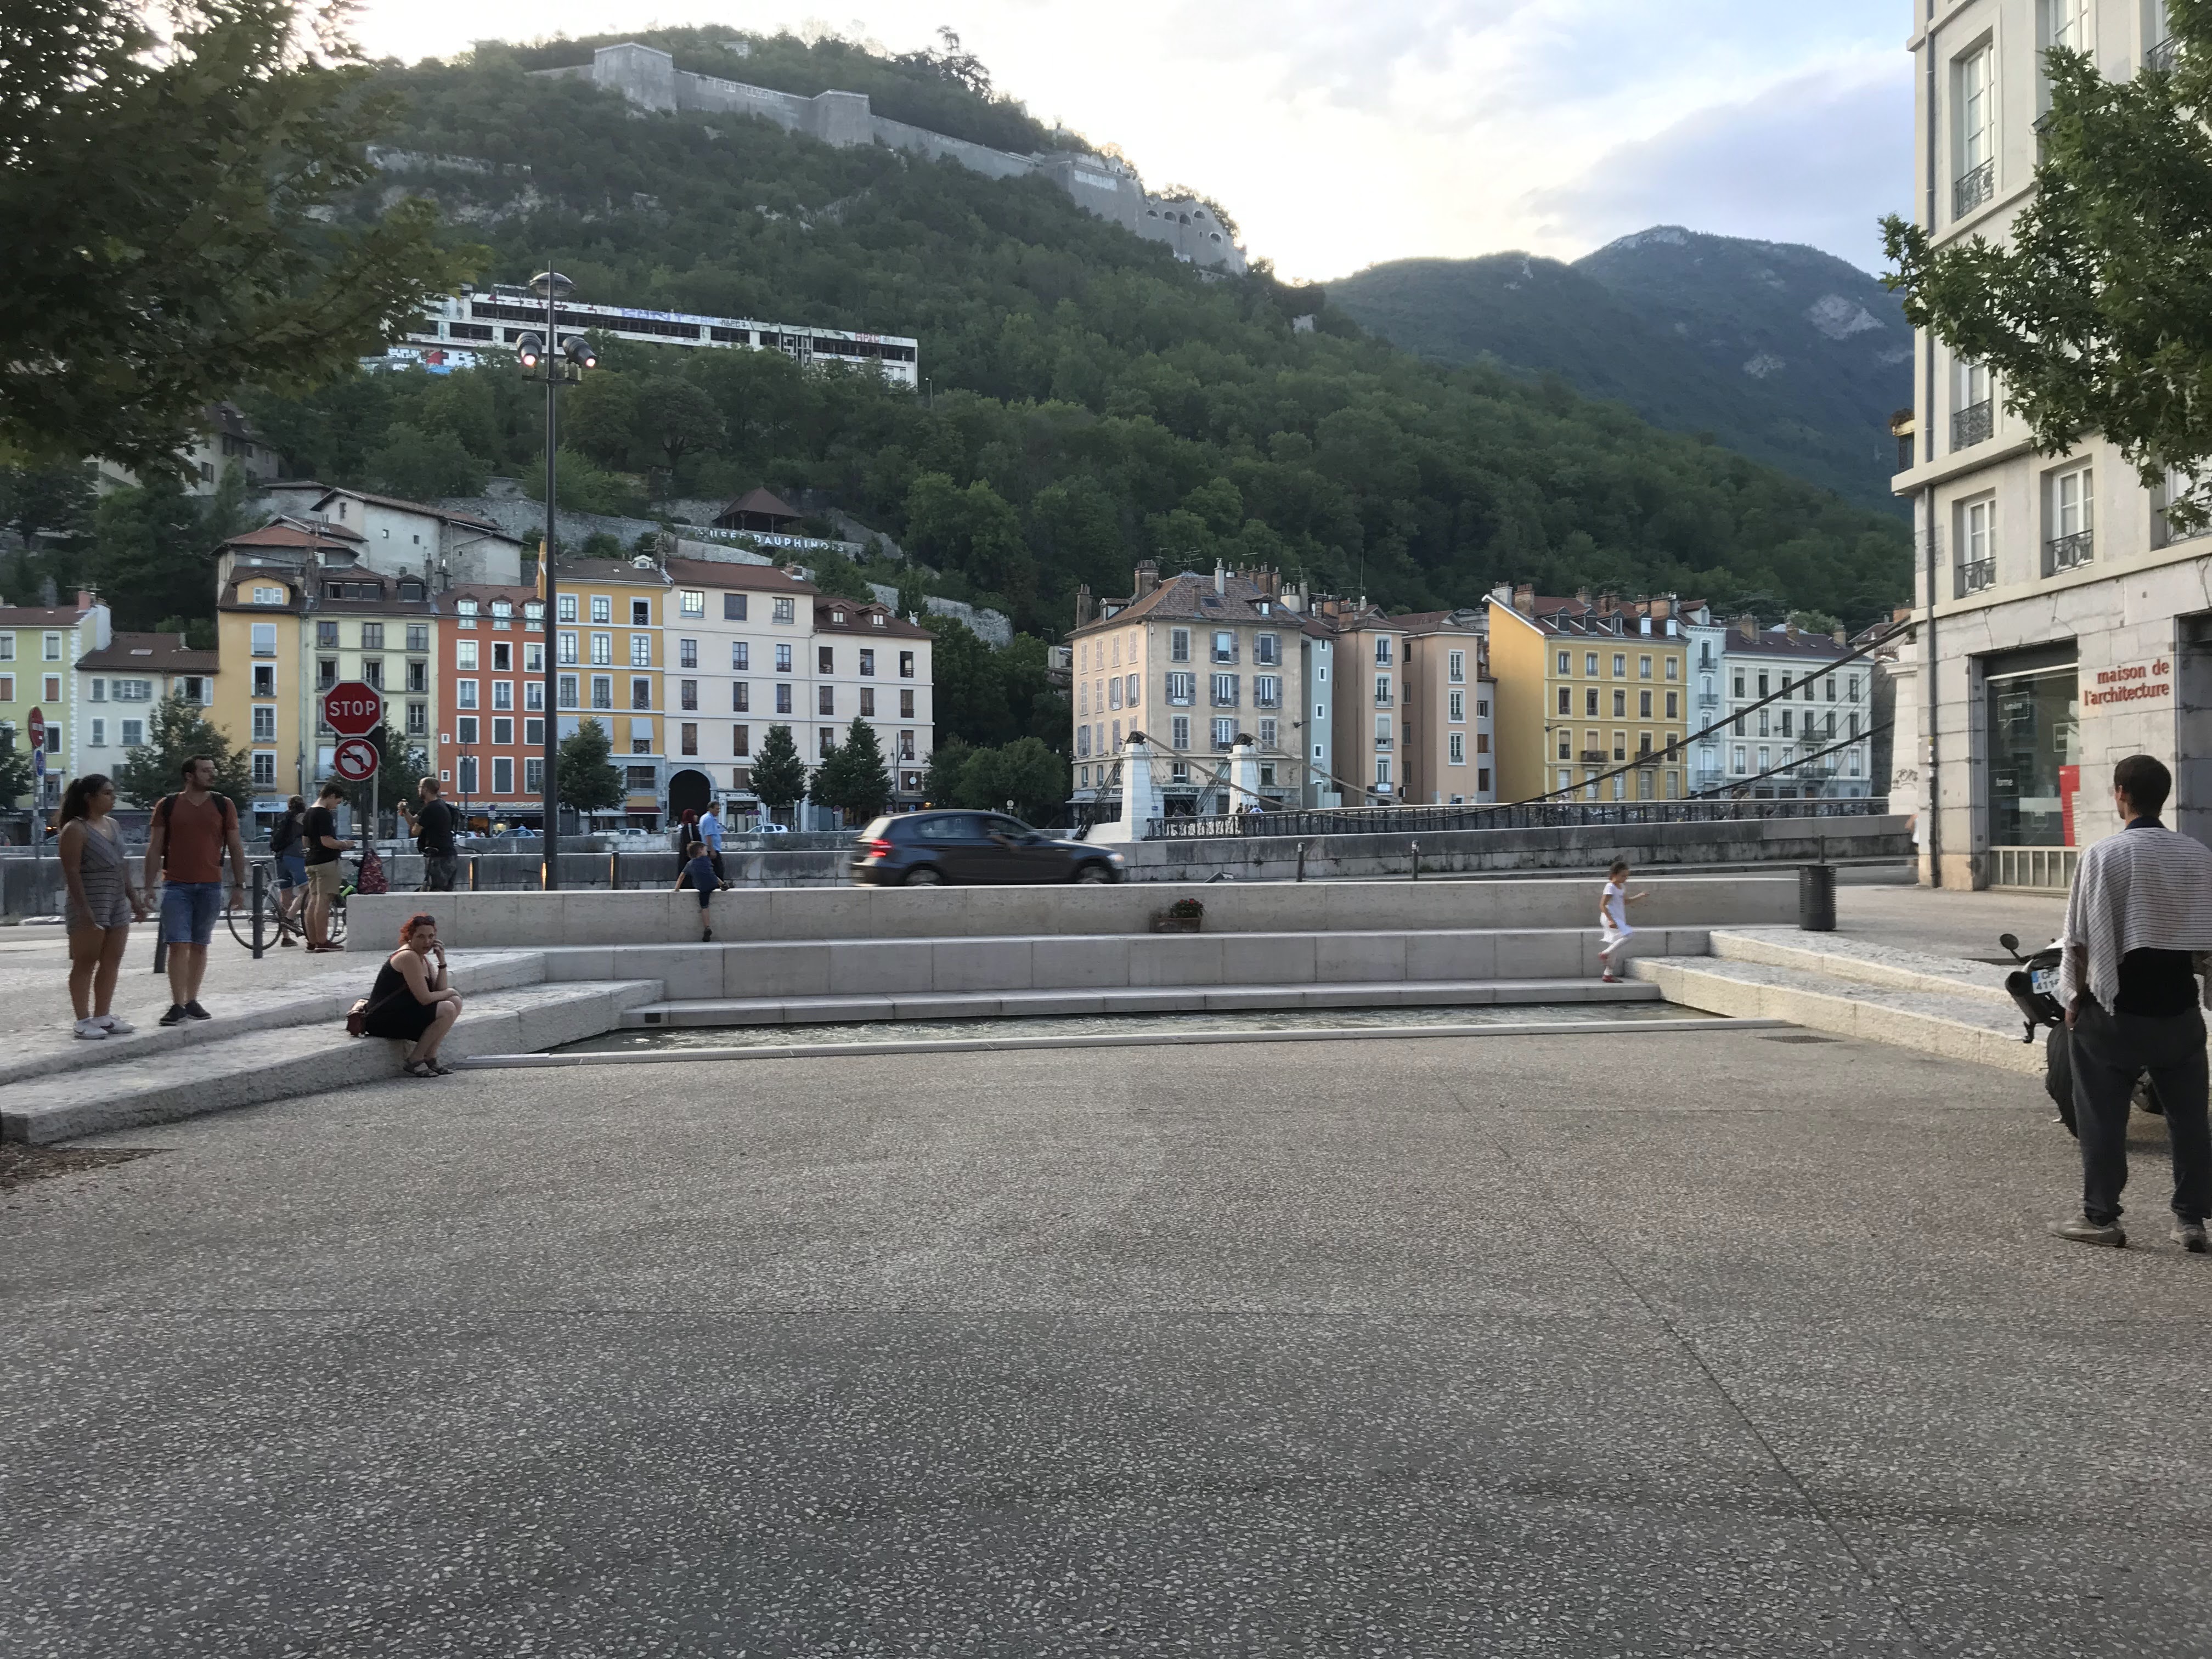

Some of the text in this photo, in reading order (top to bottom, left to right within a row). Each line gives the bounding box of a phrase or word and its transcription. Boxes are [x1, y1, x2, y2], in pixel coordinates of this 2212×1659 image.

[2097, 658, 2170, 684] maison de
[2084, 682, 2170, 706] l'architecture
[329, 700, 376, 716] STOP
